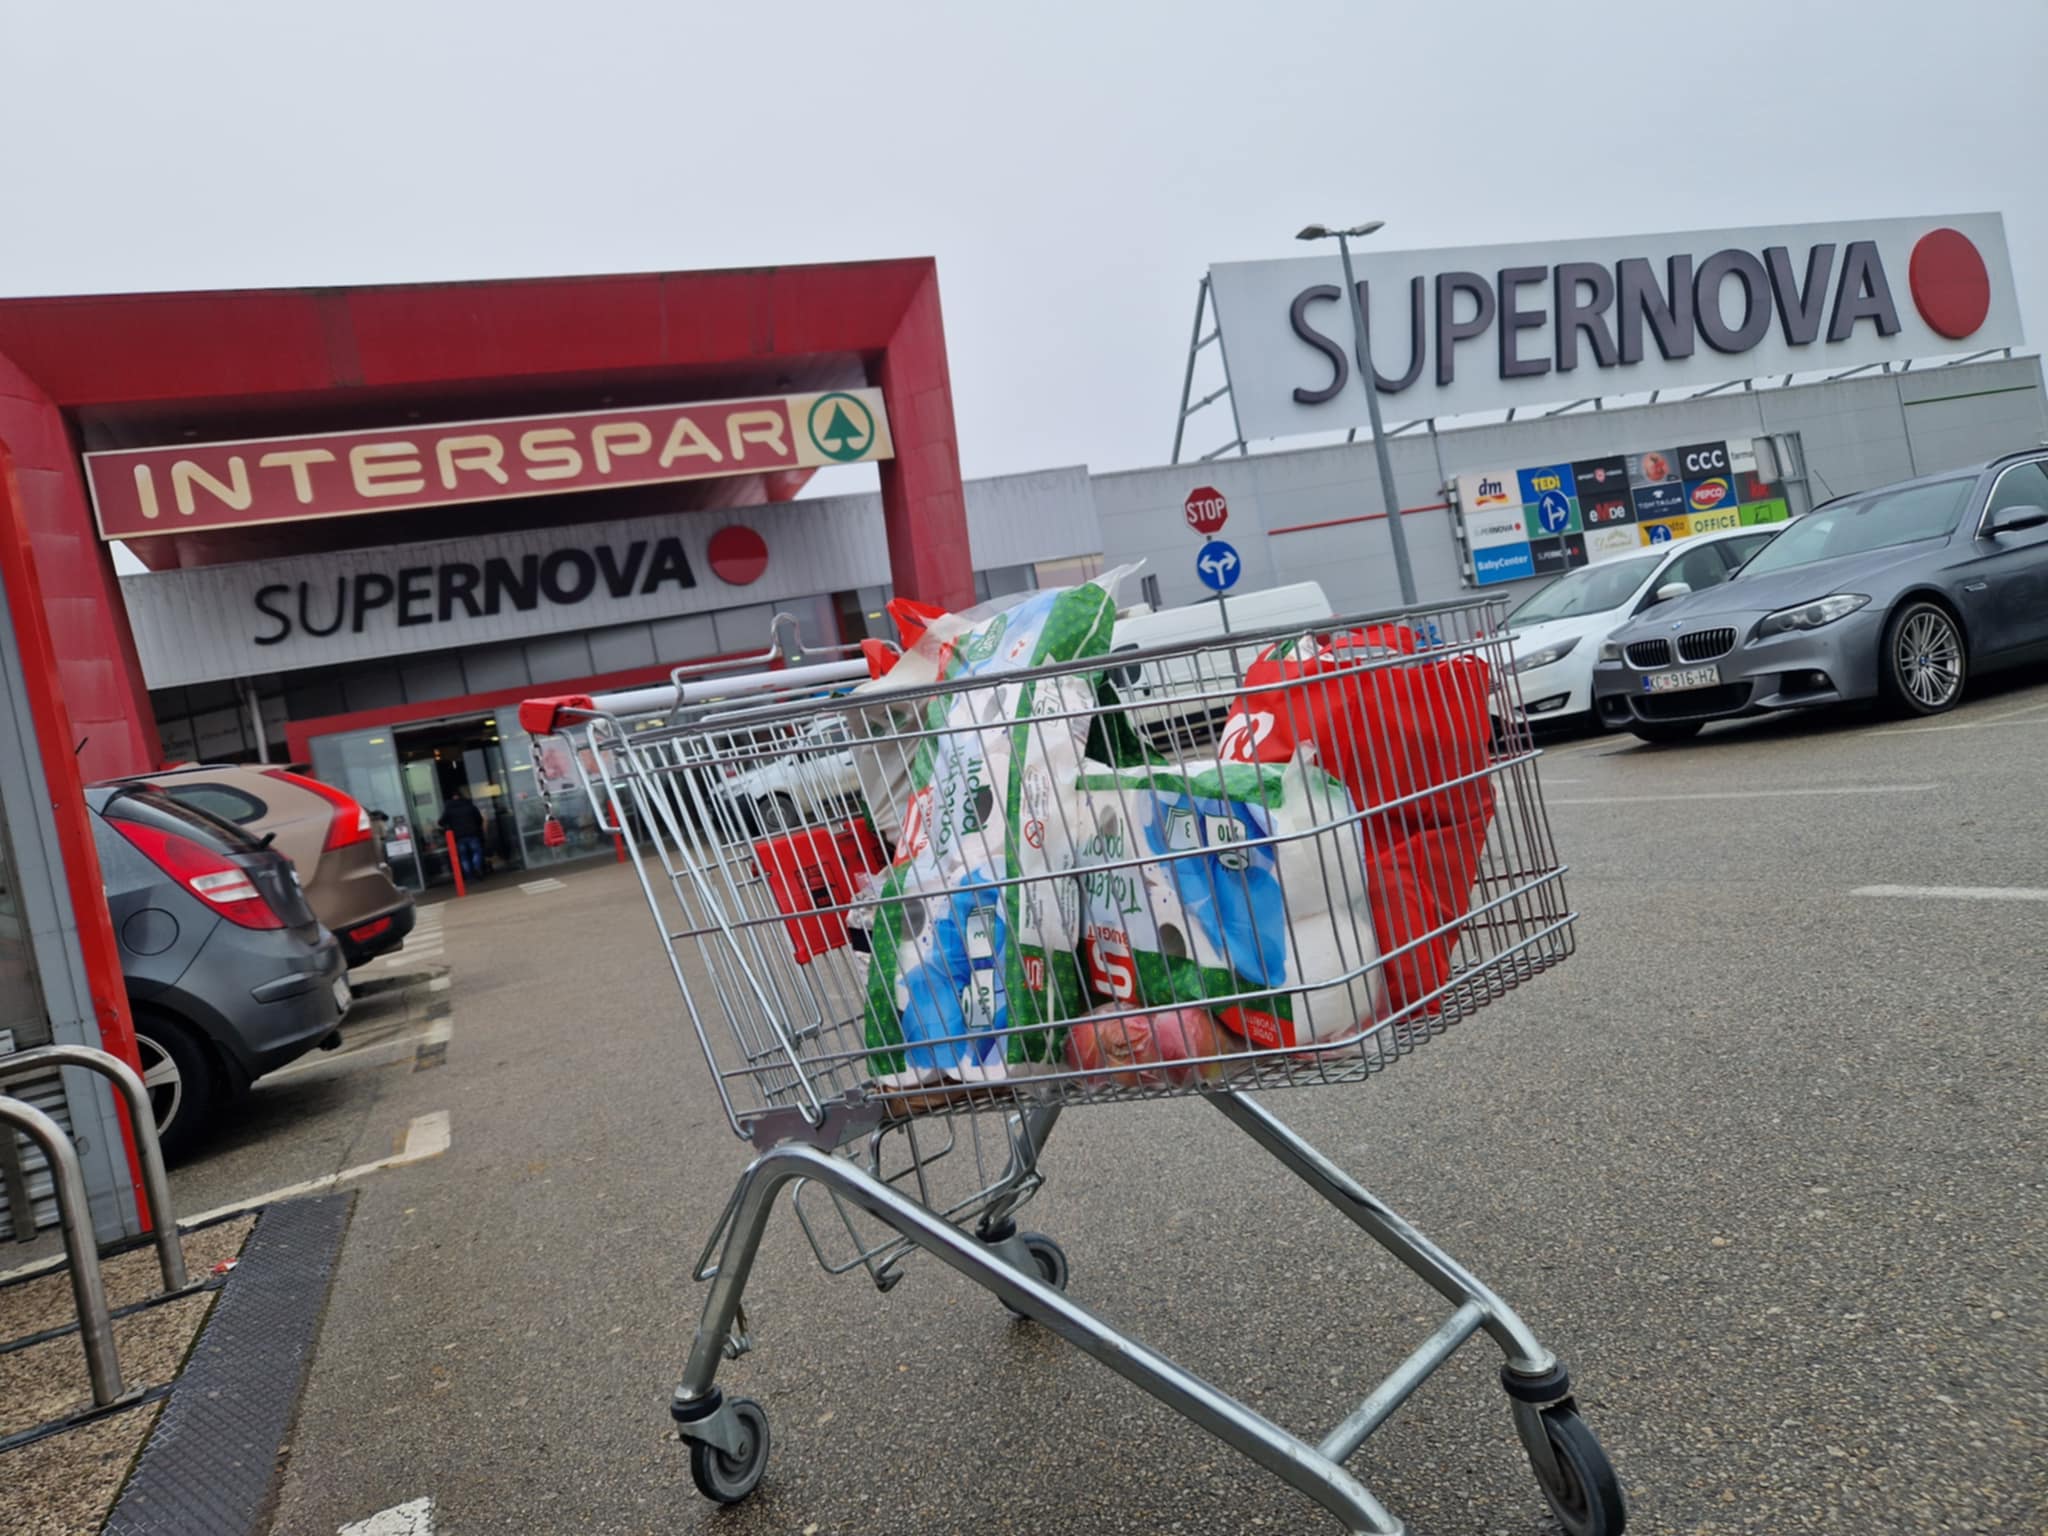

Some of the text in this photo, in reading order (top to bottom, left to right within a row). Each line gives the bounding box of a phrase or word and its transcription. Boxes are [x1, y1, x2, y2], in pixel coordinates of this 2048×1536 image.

[1289, 240, 1901, 405] SUPERNOVA
[133, 410, 789, 519] INTERSPAR
[1686, 449, 1725, 472] CCC
[1478, 477, 1503, 496] dm
[1186, 498, 1225, 523] STOP
[1694, 514, 1736, 533] OFFICE
[1477, 555, 1529, 571] BabyCenter
[253, 536, 697, 646] SUPERNOVA
